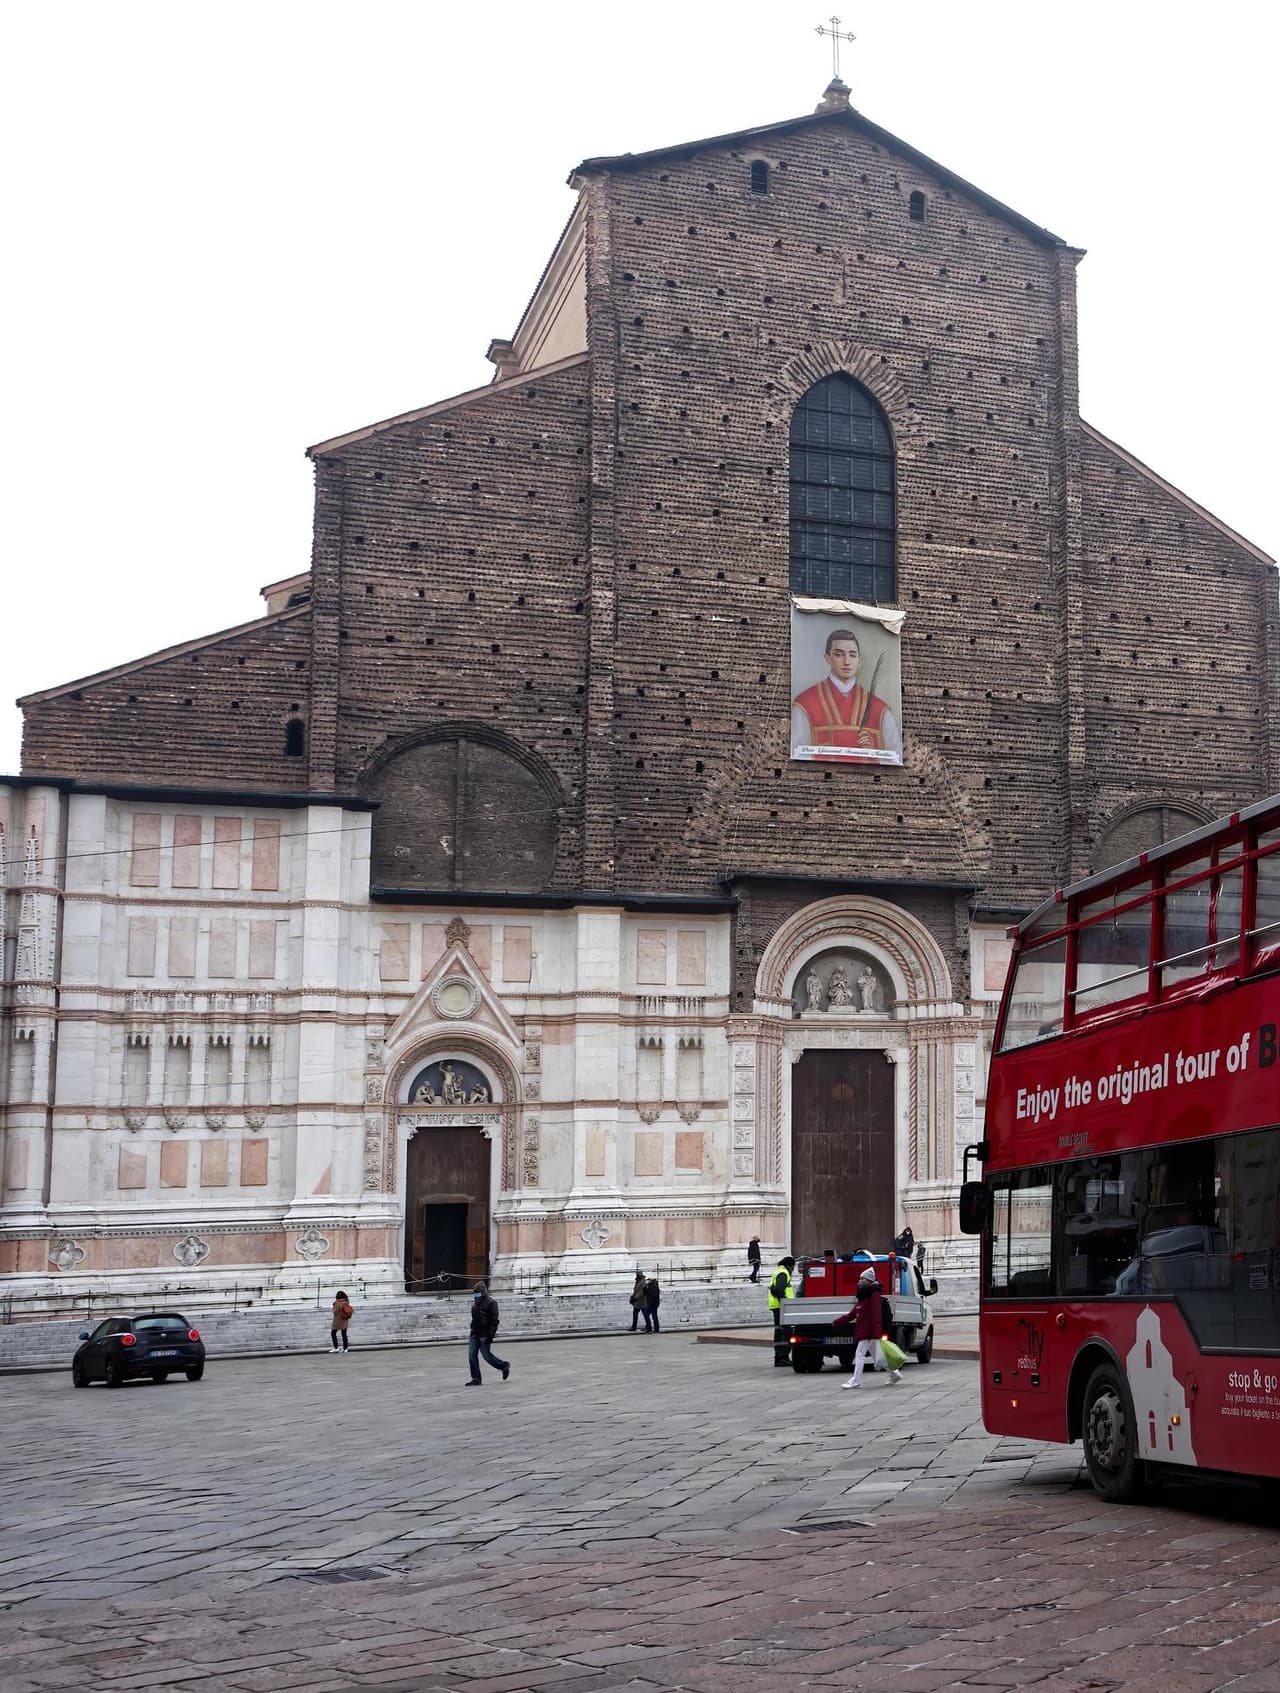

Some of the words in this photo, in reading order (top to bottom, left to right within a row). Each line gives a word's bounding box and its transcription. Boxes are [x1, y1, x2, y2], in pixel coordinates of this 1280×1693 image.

[1016, 1083, 1060, 1124] Enjoy
[1064, 1074, 1092, 1109] the
[1097, 1053, 1169, 1105] original
[1175, 1049, 1220, 1083] tour
[1226, 1032, 1250, 1073] of
[1017, 1318, 1045, 1368] City
[1017, 1354, 1037, 1370] redbus
[1228, 1370, 1251, 1393] stop
[1253, 1368, 1262, 1388] &
[1264, 1375, 1278, 1394] go
